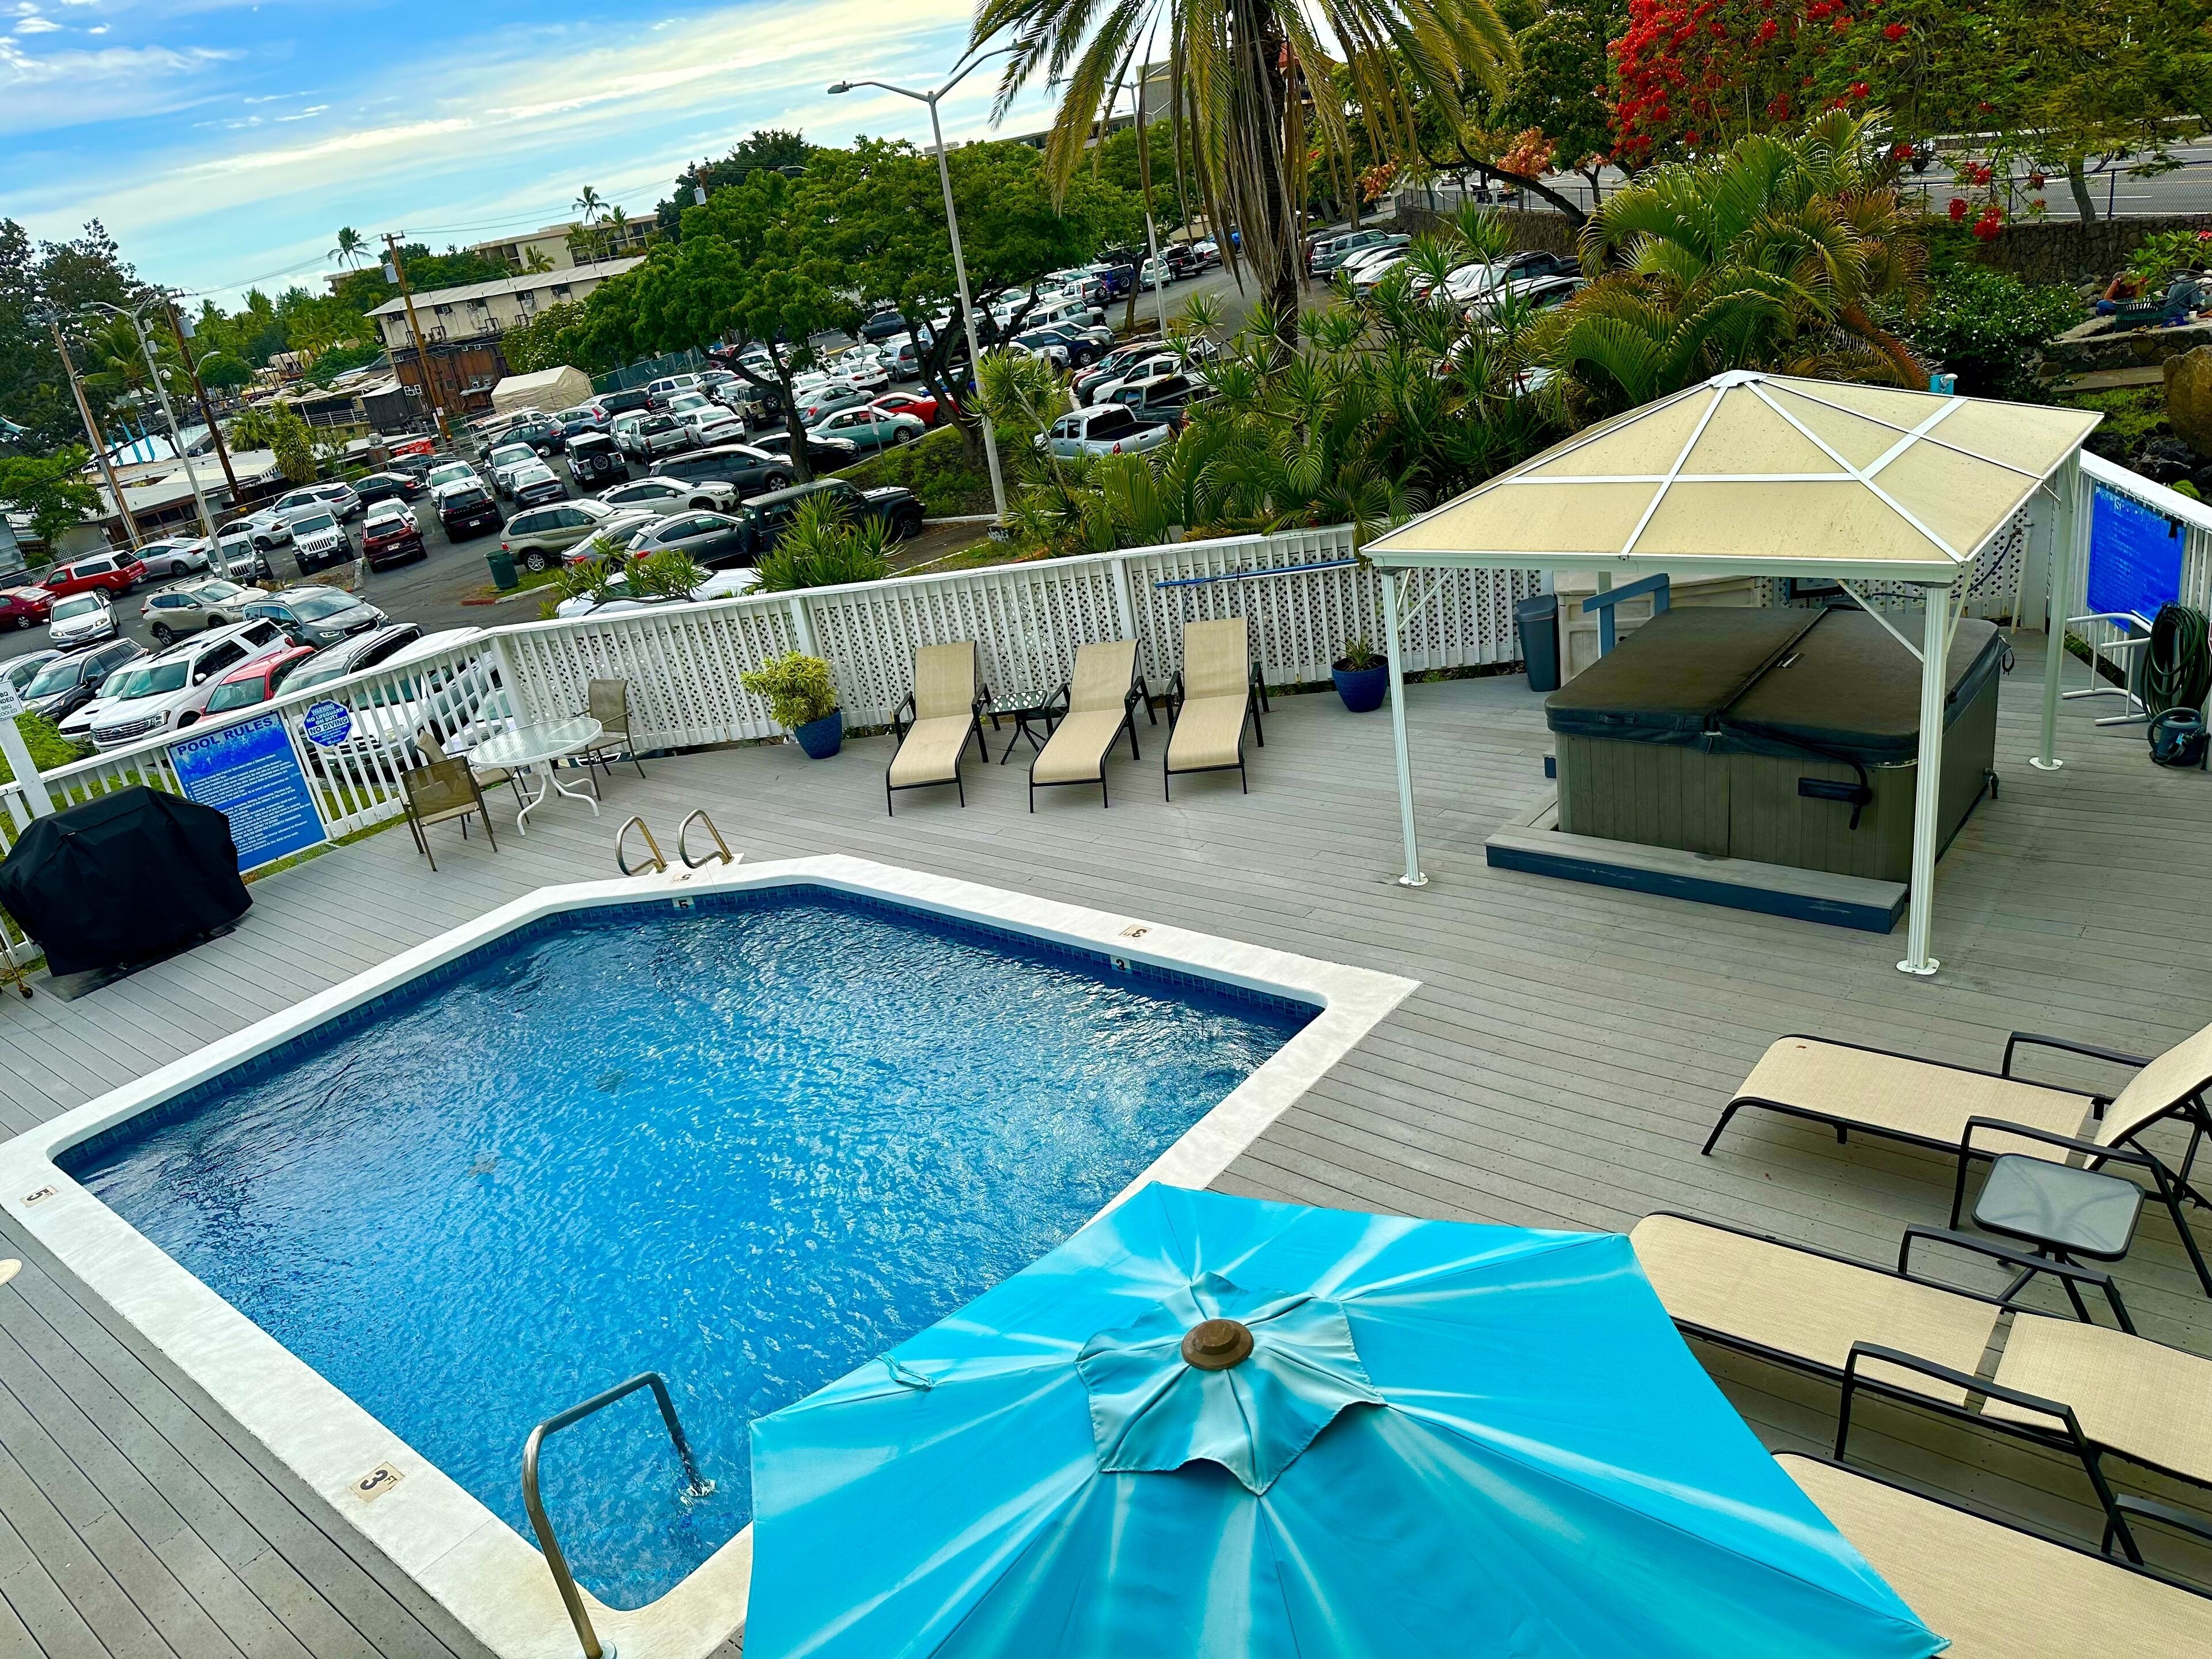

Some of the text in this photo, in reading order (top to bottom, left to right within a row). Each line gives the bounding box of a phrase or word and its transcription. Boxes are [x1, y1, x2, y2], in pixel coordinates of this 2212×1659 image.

[311, 703, 335, 715] WARNING
[316, 707, 344, 719] LIFEGUARD
[309, 726, 321, 734] NO
[323, 717, 348, 730] DIVING
[177, 717, 273, 756] POOL RULES
[678, 899, 690, 909] 5
[1131, 929, 1147, 937] 3
[26, 1188, 50, 1201] 5
[360, 1469, 398, 1490] 3 FT
